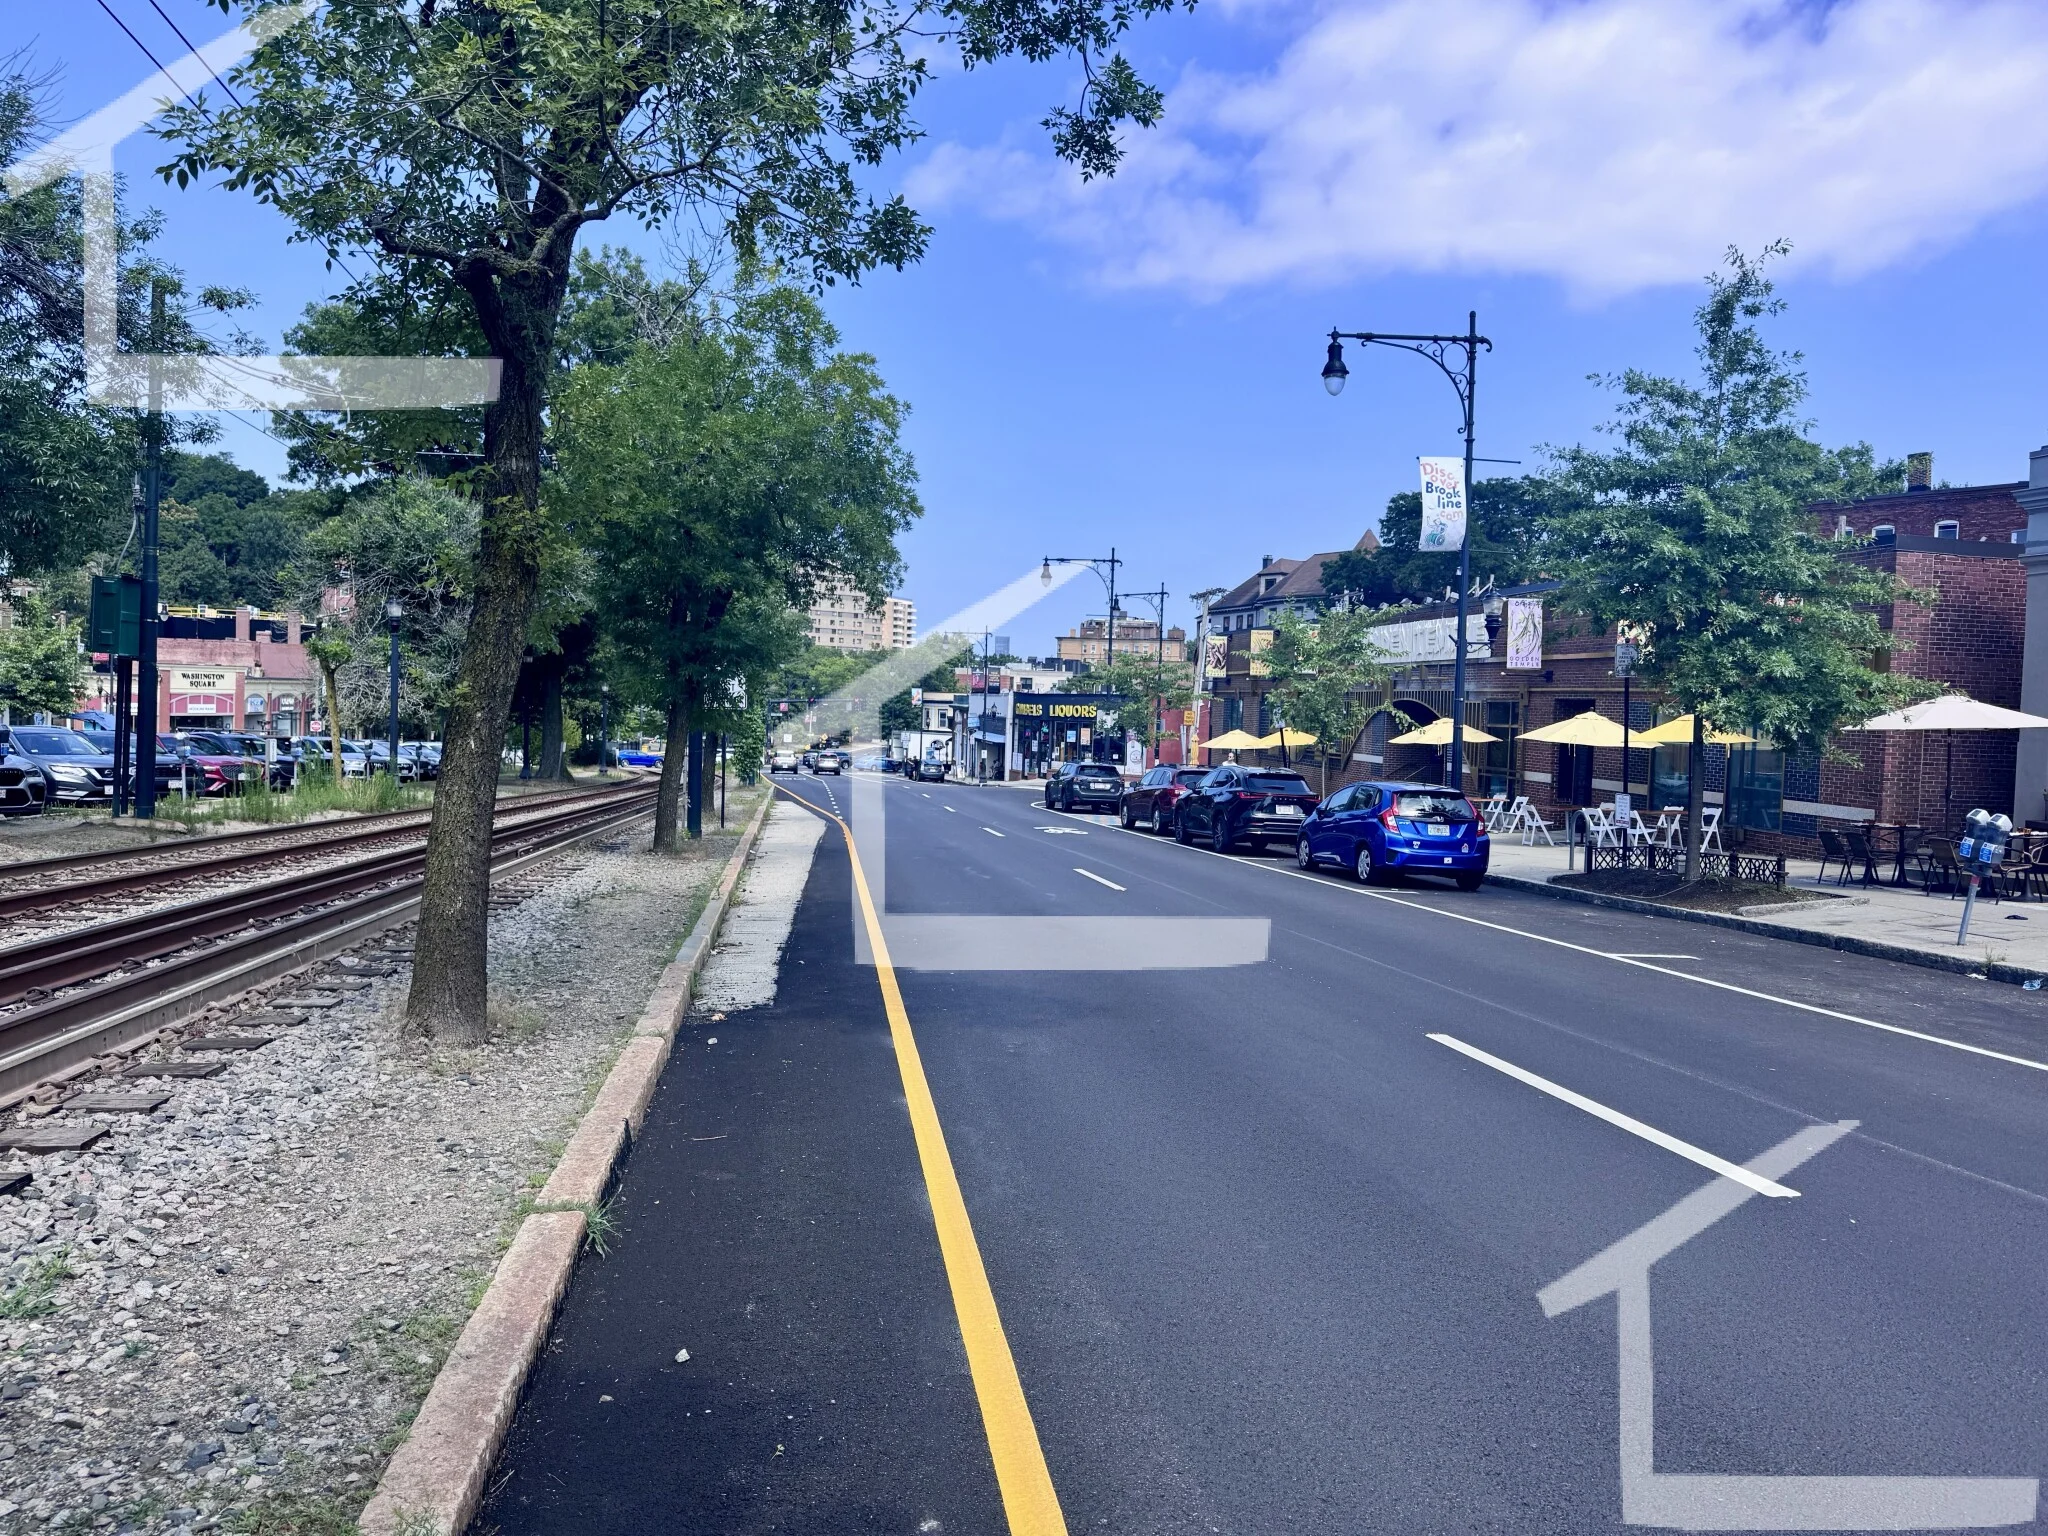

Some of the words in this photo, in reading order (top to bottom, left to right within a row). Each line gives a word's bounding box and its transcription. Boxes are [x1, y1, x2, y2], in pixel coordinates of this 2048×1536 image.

[1422, 463, 1454, 480] Disc
[1430, 474, 1459, 489] over
[1426, 481, 1461, 499] Brook
[1437, 495, 1462, 509] line
[1049, 704, 1097, 718] LIQUORS
